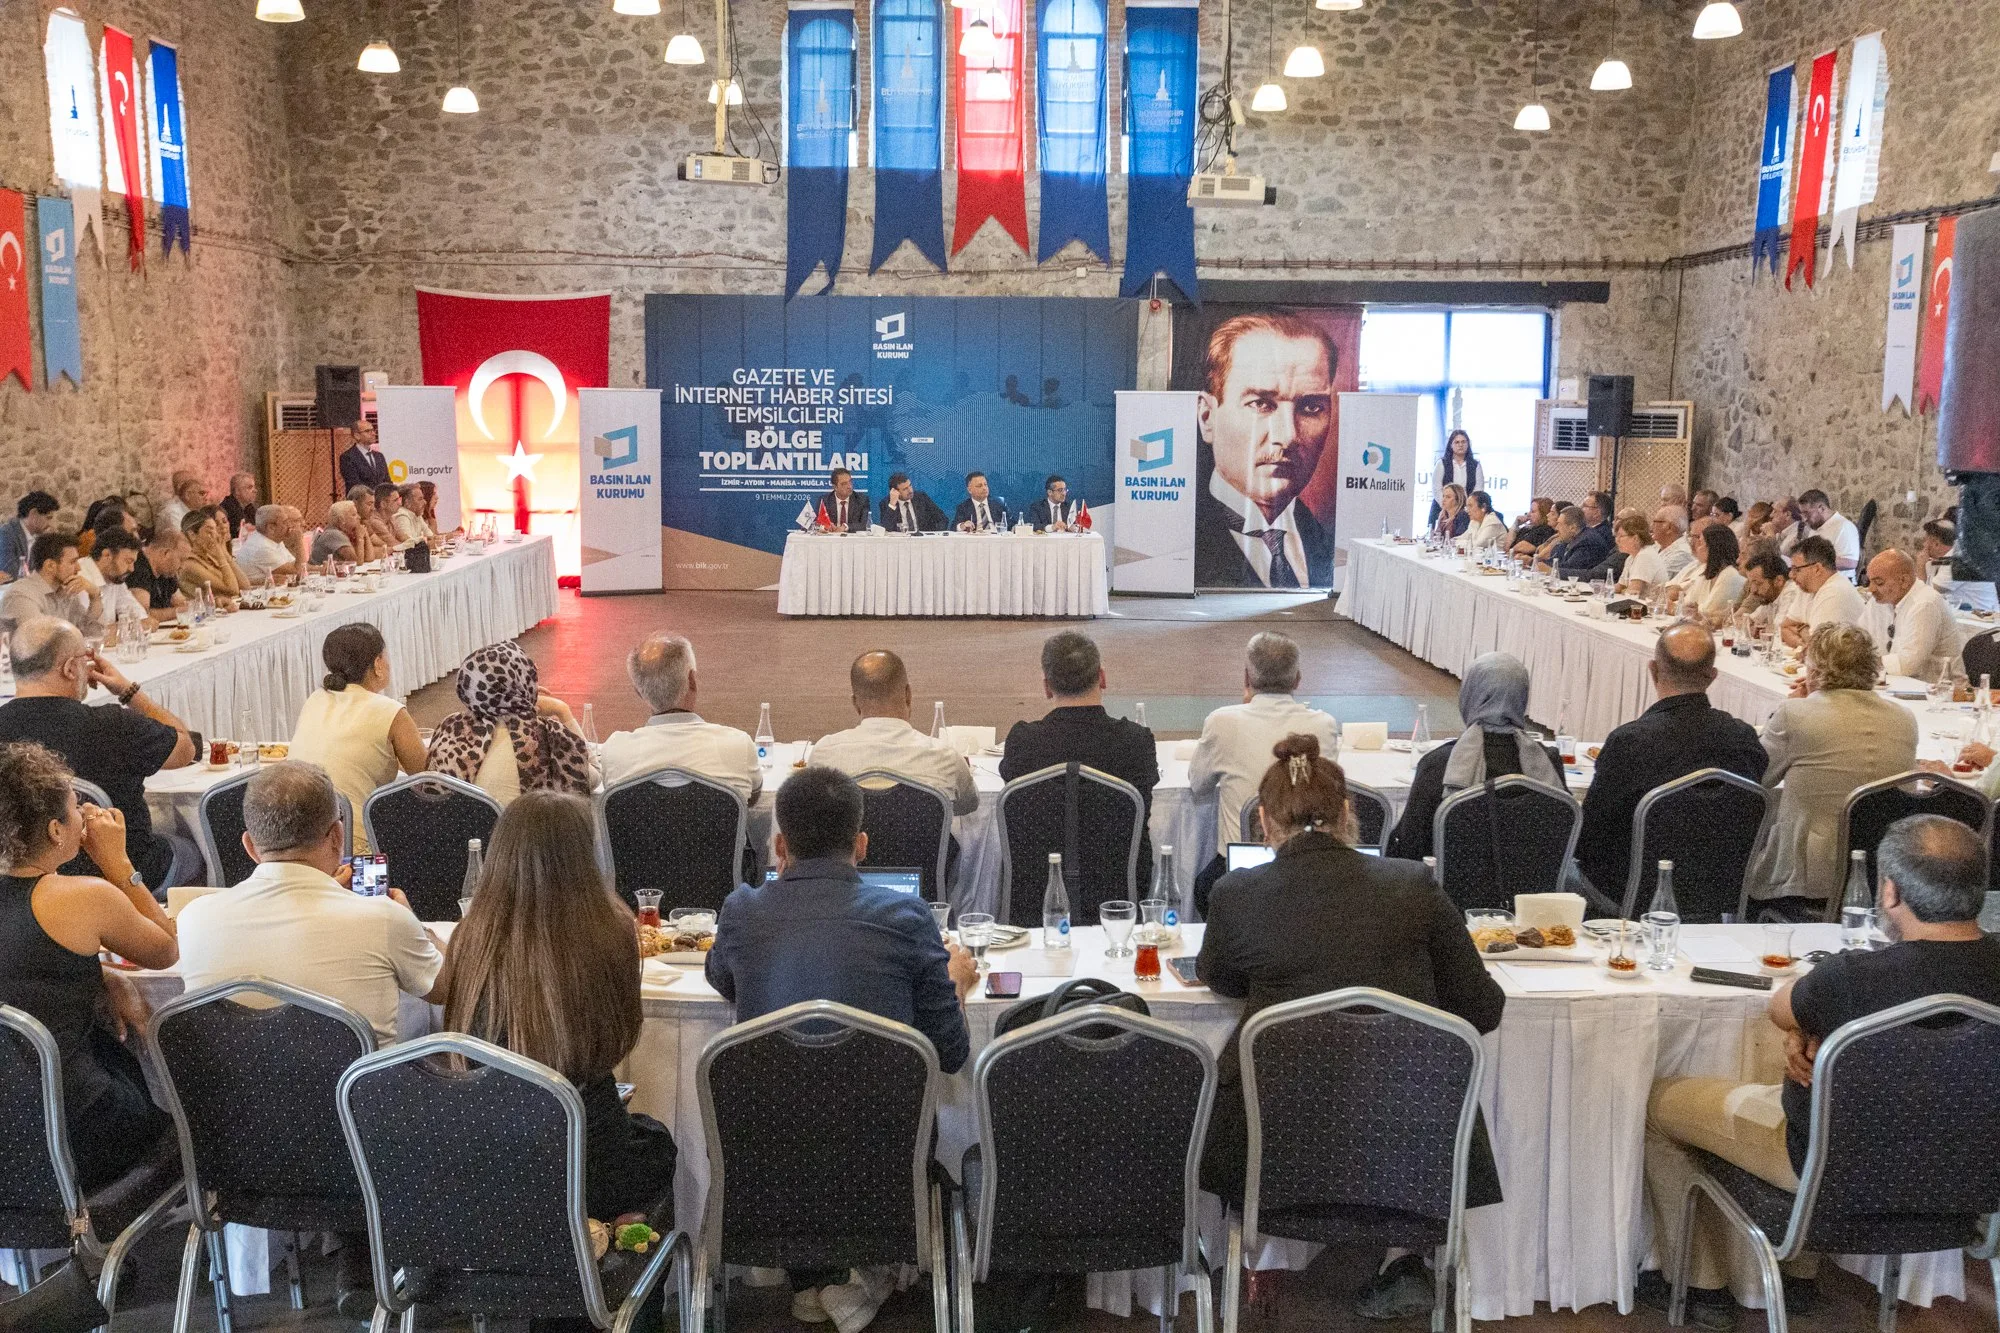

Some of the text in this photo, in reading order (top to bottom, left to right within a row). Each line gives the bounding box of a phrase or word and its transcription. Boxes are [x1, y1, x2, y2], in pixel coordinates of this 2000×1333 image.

[732, 368, 835, 385] GAZETE VE
[675, 384, 892, 405] İNTERNET HABER SİTESİ
[745, 426, 822, 448] BÖLGE
[699, 452, 868, 471] TOPLANTILARI
[590, 475, 623, 484] BASIN
[1125, 477, 1157, 486] BASIN
[1370, 479, 1405, 491] Analitik
[597, 489, 644, 498] KURUMU
[1131, 491, 1178, 501] KURUMU
[676, 562, 729, 570] www.bik.gov.tr
